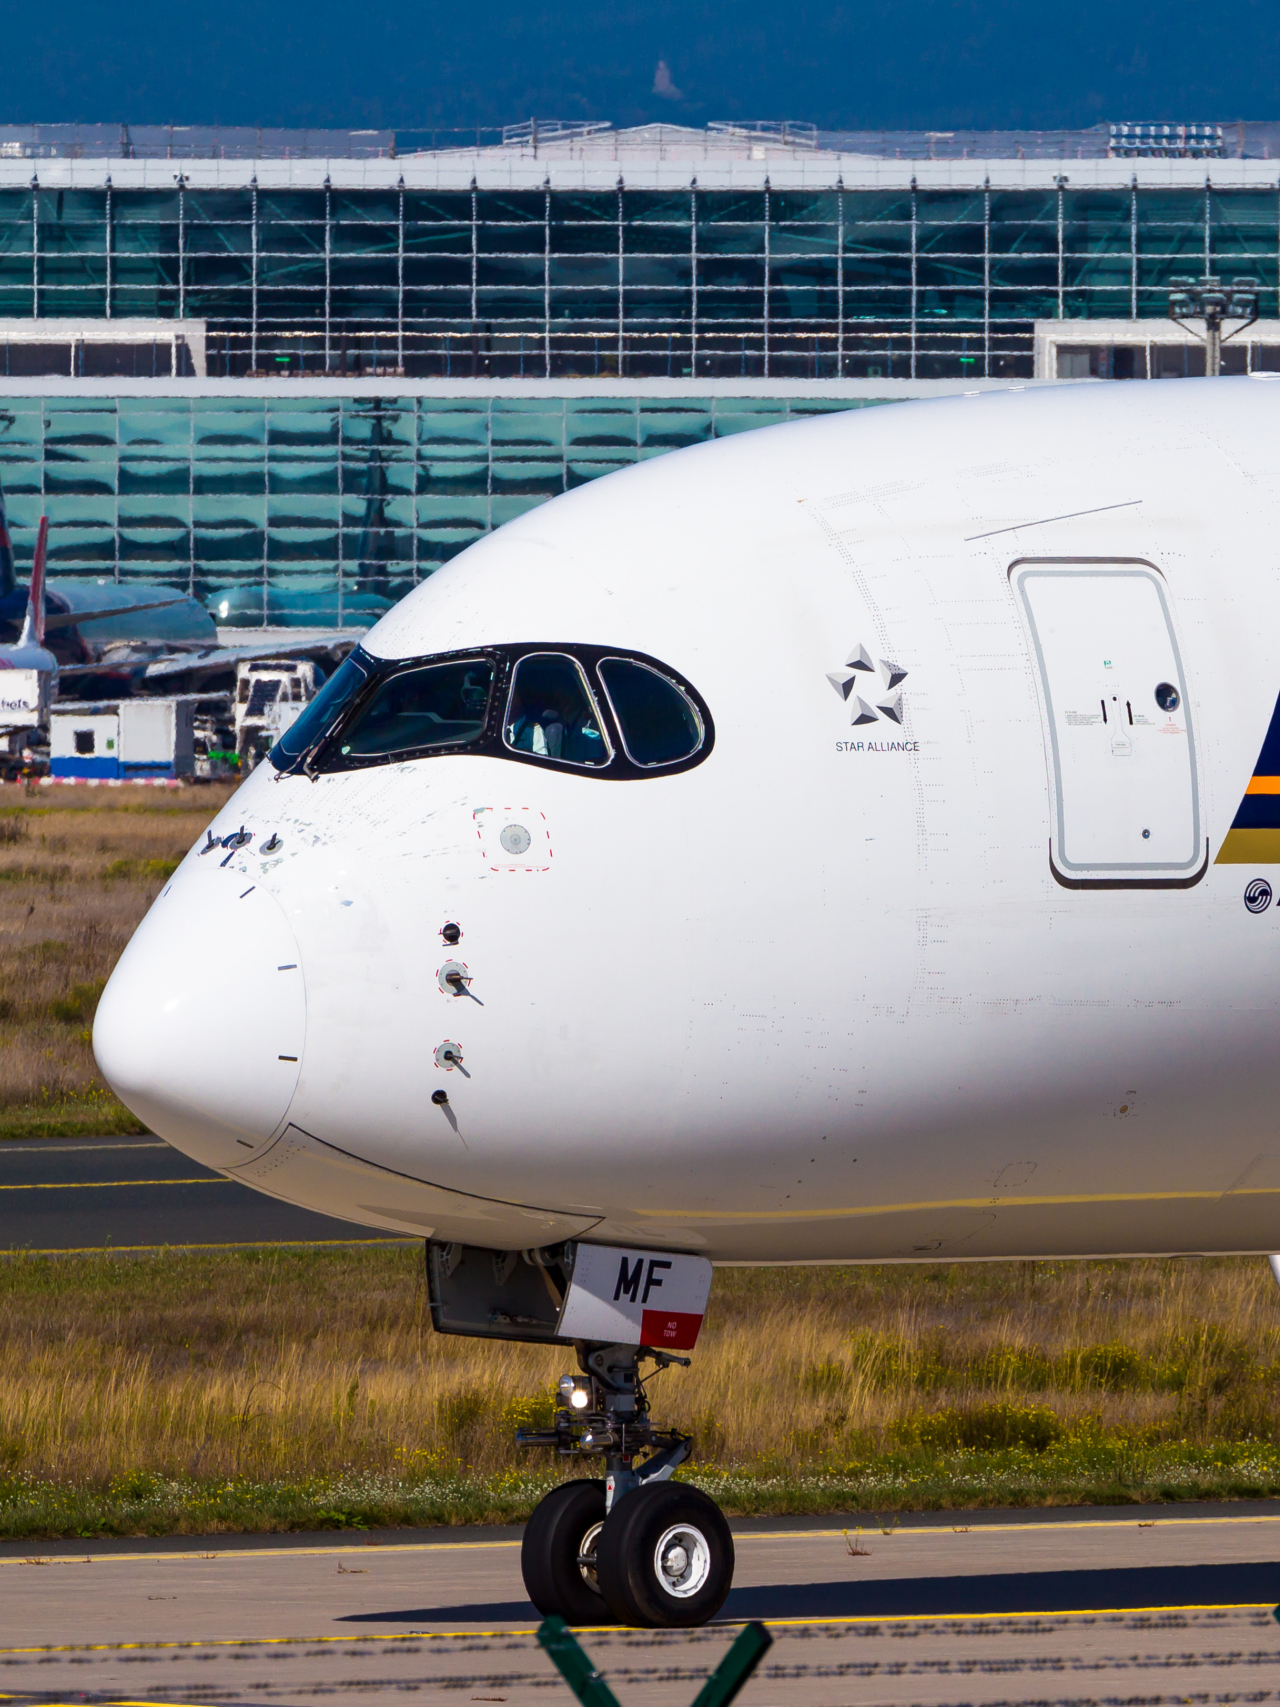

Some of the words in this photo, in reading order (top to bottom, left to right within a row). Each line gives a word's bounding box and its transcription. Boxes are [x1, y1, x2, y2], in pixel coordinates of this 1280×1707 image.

[835, 741, 865, 752] STAR
[867, 741, 920, 752] ALLIANCE
[613, 1256, 672, 1304] MF
[666, 1321, 677, 1329] NO
[663, 1329, 677, 1338] TOW
